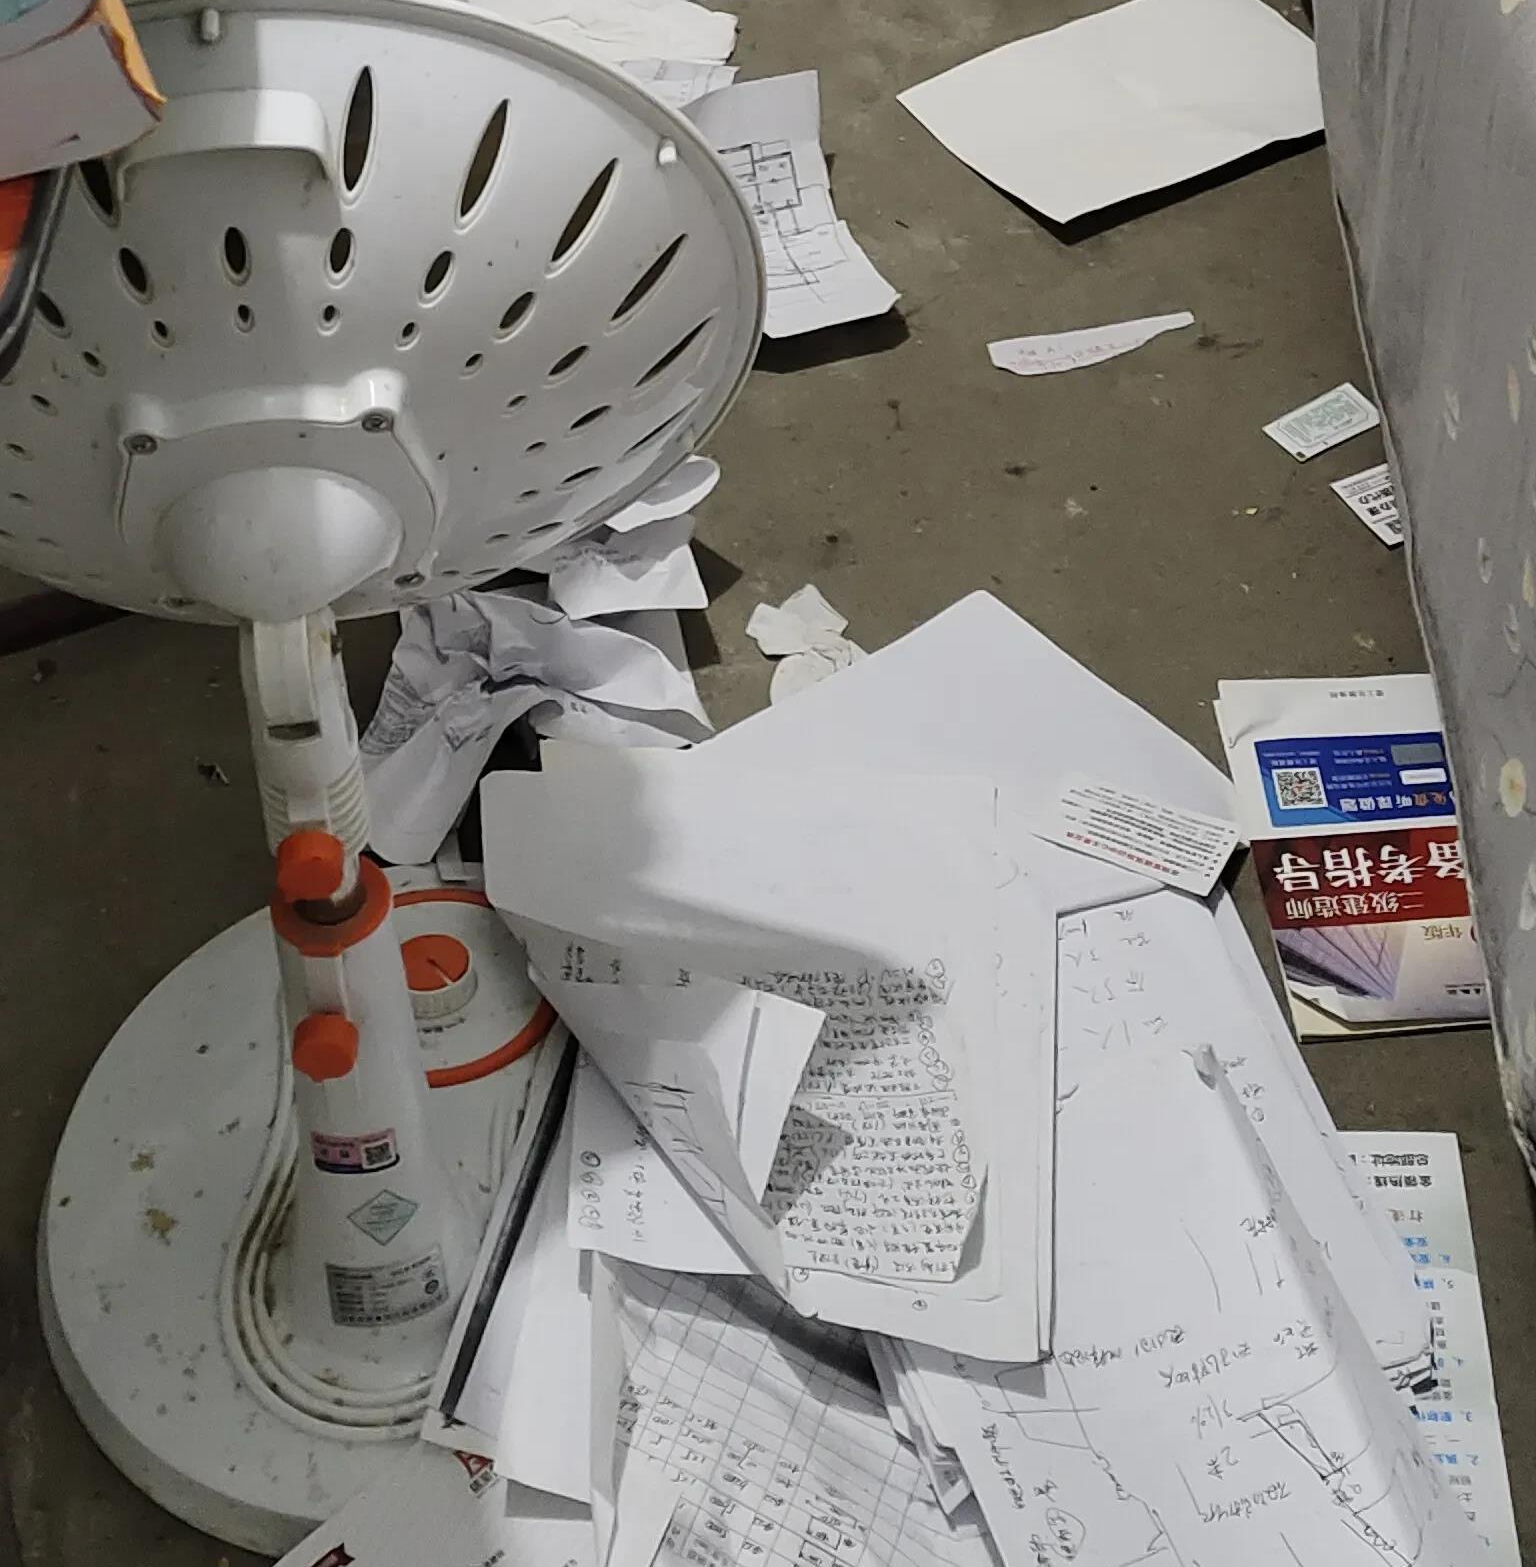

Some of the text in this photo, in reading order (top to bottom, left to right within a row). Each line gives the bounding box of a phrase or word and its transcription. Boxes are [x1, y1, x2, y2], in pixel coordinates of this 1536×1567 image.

[1272, 841, 1466, 893] 备考指导
[1285, 891, 1425, 920] 二级建造师
